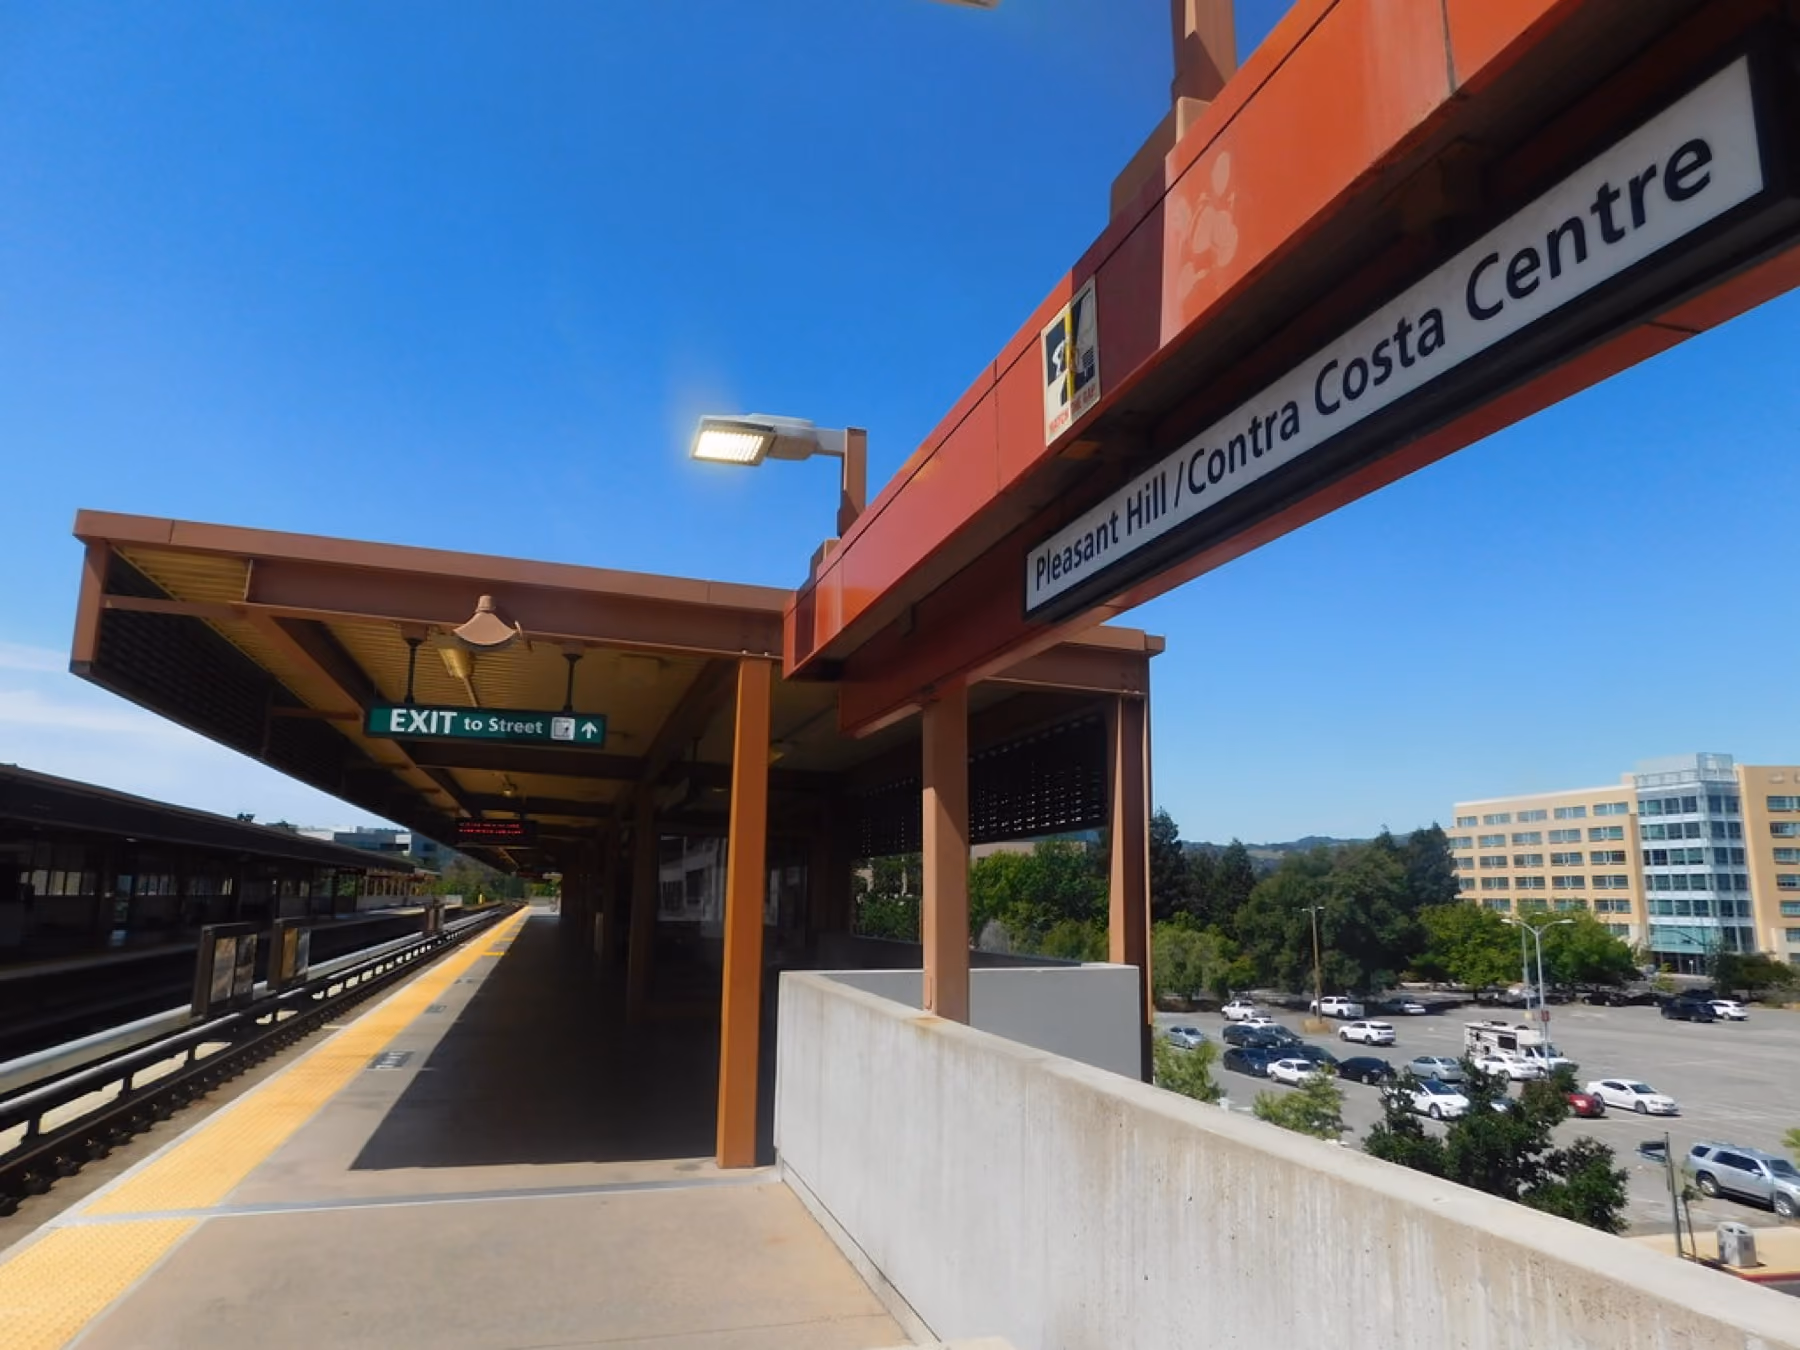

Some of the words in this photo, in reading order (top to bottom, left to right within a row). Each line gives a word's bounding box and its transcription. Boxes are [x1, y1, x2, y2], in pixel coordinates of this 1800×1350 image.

[1036, 513, 1119, 592] Pleasant
[1314, 307, 1446, 417] Costa
[1465, 137, 1713, 321] Centre
[389, 708, 458, 735] EXIT
[463, 717, 483, 731] to
[488, 717, 544, 734] Street
